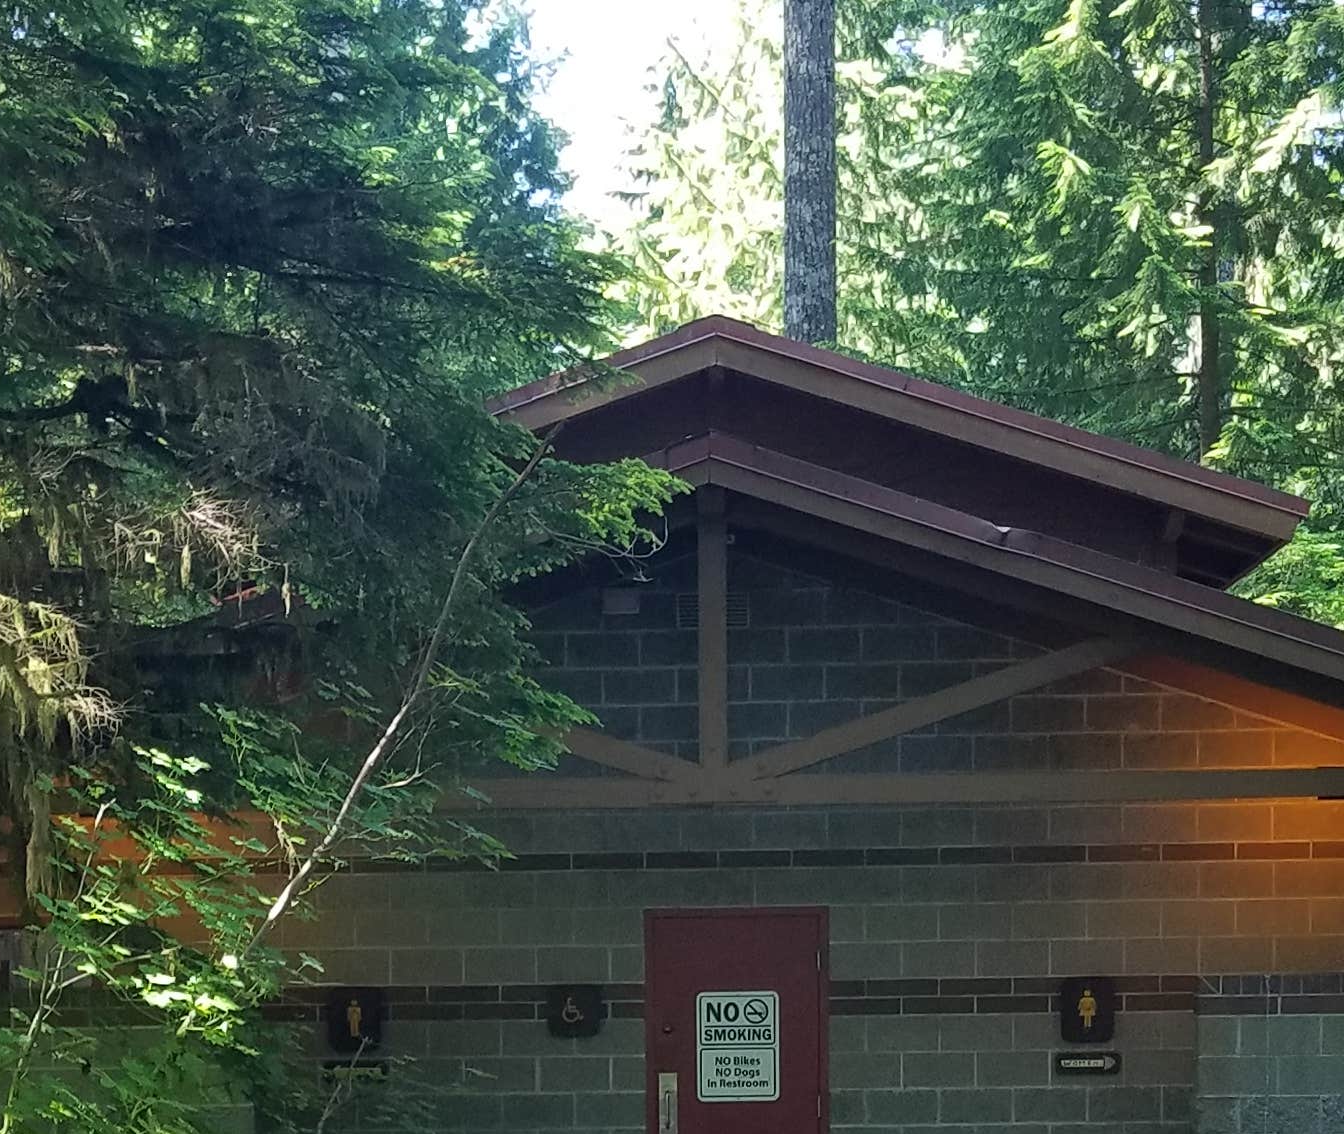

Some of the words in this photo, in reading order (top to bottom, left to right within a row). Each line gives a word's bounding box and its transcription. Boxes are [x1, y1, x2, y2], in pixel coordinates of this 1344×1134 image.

[706, 1002, 739, 1022] NO
[704, 1028, 771, 1041] SMOKING
[715, 1056, 731, 1066] NO
[733, 1056, 760, 1066] Bikes
[715, 1068, 731, 1077] NO
[734, 1068, 760, 1078] Dogs
[719, 1079, 769, 1088] Restroom
